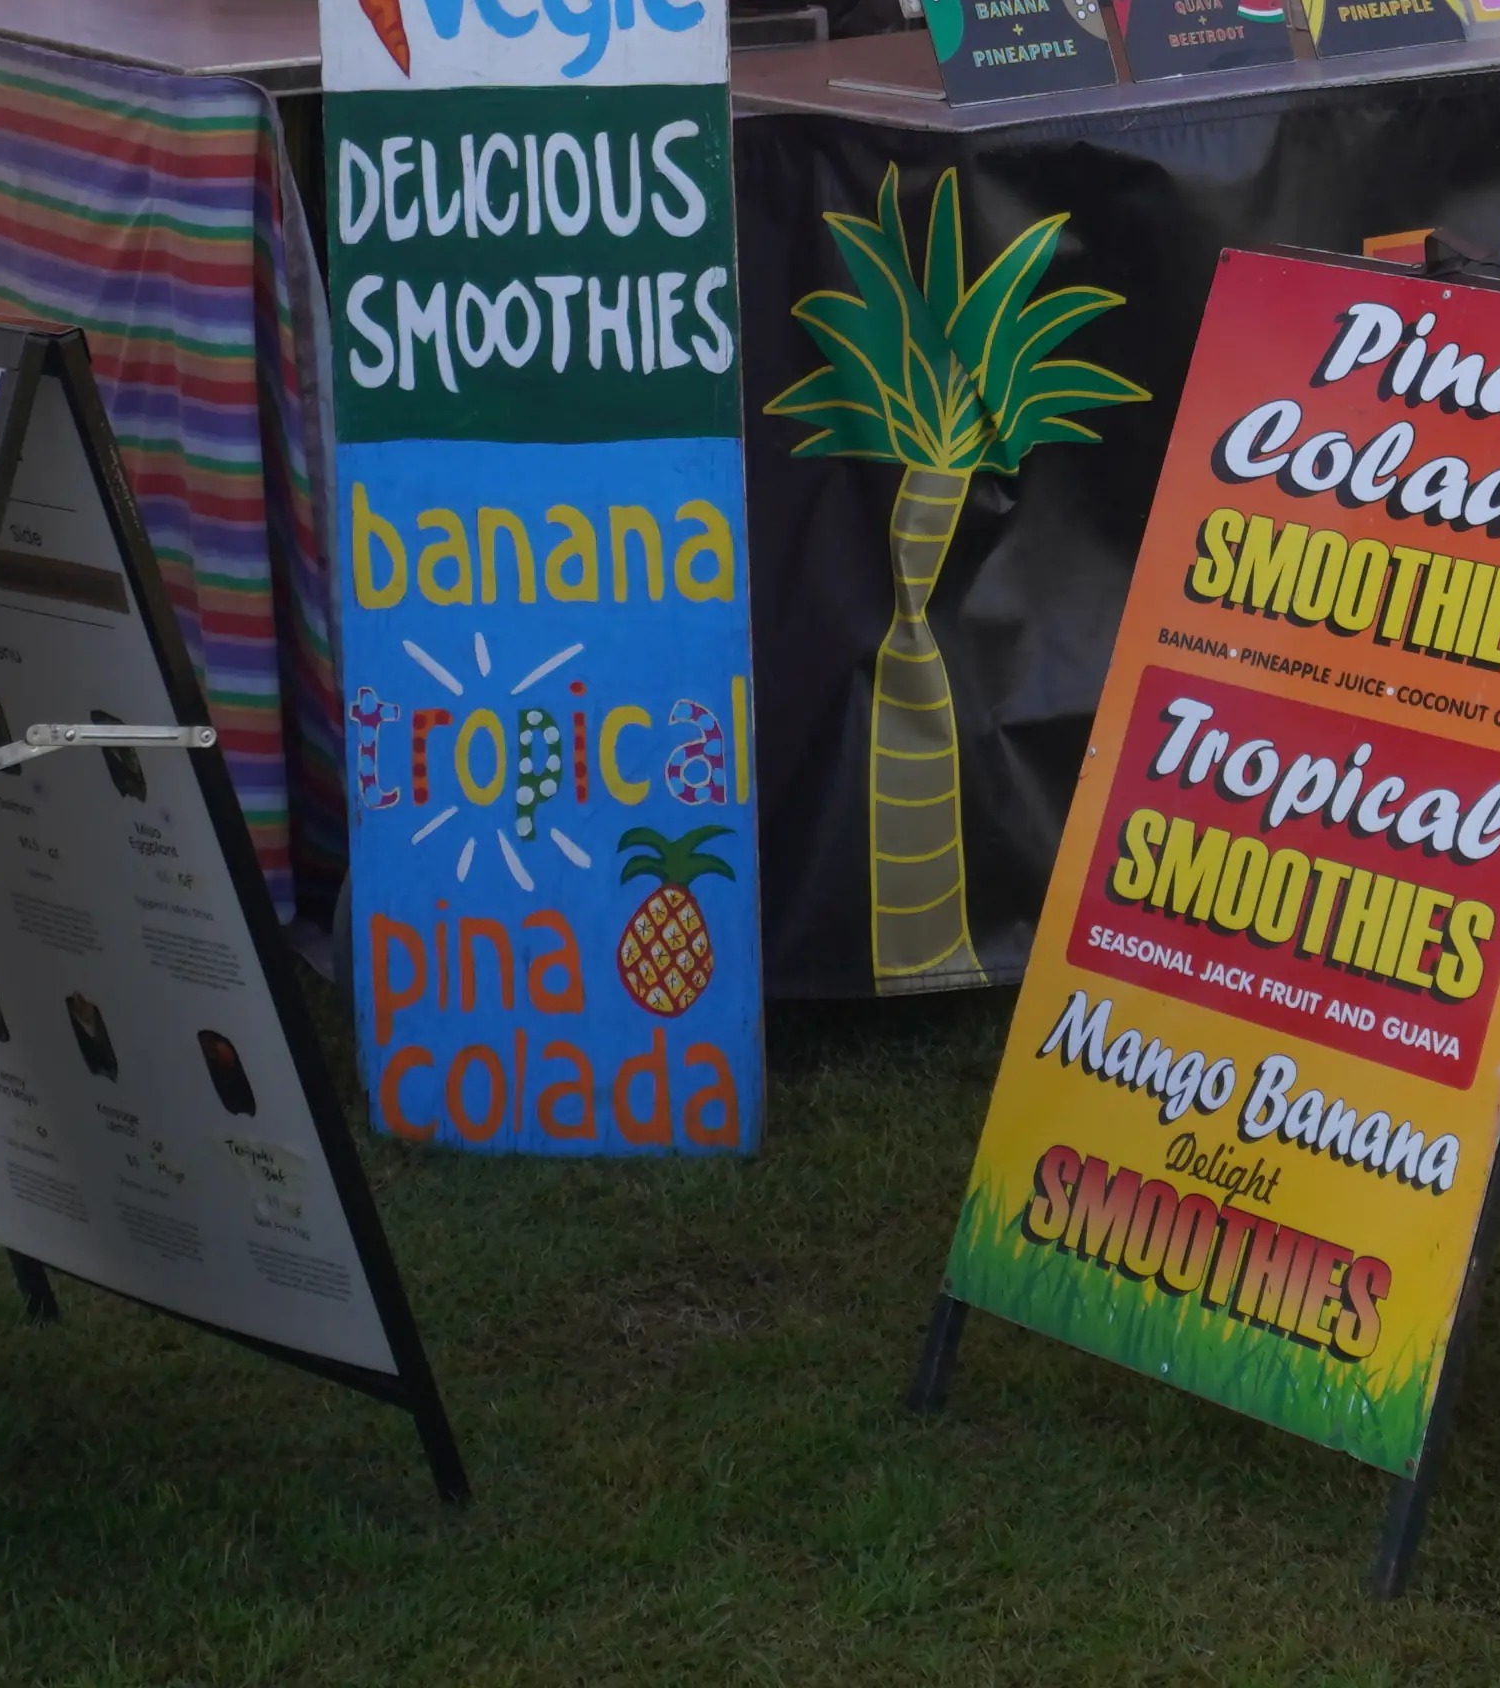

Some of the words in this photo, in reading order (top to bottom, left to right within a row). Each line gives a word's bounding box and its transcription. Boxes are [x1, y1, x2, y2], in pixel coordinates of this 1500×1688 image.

[972, 39, 1077, 68] PINEAPPLE
[1168, 25, 1245, 49] BEETROOT
[339, 118, 702, 247] DELICIOUS
[345, 265, 735, 395] SMOOTHIES
[9, 524, 43, 548] Side
[350, 481, 736, 610] banana
[1157, 626, 1229, 661] BANANA
[1240, 646, 1331, 686] PINEAPPLE
[1334, 670, 1386, 699] JUICE
[1396, 684, 1489, 723] COCONUT
[348, 675, 750, 843] tropical
[1110, 807, 1497, 1000] SMOOTHIES
[368, 898, 585, 1048] pina
[1086, 924, 1195, 979] SEASONAL
[1199, 959, 1256, 996] JACK
[1258, 977, 1322, 1015] FRUIT
[1324, 998, 1377, 1033] AND
[1381, 1017, 1462, 1061] GUAVA
[377, 1027, 742, 1152] colada
[1040, 988, 1237, 1122] Mango
[1242, 1052, 1462, 1193] Banana
[1164, 1130, 1282, 1207] Delight
[1025, 1143, 1393, 1360] SMOOTHIES
